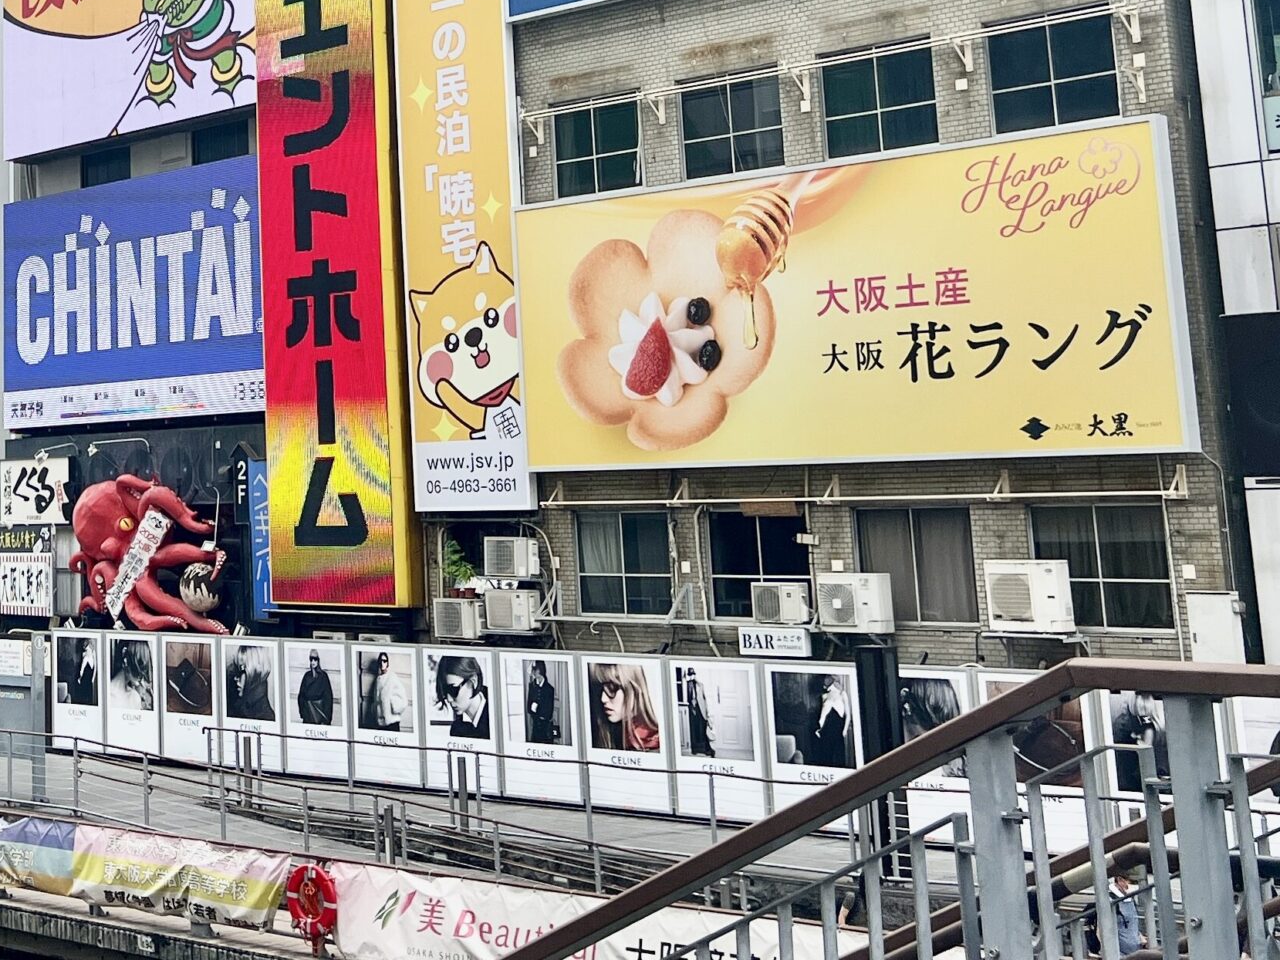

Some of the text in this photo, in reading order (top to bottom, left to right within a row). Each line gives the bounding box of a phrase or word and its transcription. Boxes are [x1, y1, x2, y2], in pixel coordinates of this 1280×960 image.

[961, 152, 1069, 214] Hana
[1000, 174, 1138, 238] Langue
[16, 188, 254, 365] CHINTAI
[816, 267, 971, 317] 大阪土産
[822, 303, 1153, 383] 大阪 花ラング
[1087, 412, 1133, 437] 大黒
[427, 451, 514, 472] www.jsv.jp
[13, 467, 55, 514] くくる
[427, 478, 517, 494] 06-4963-3661
[140, 527, 160, 545] 2025
[742, 633, 775, 650] BAR
[68, 709, 87, 717] CELINE
[122, 713, 143, 722] CELINE
[178, 718, 200, 727] CELINE
[305, 729, 329, 738] CELINE
[373, 735, 398, 745] CELINE
[526, 748, 555, 758] CELINE
[611, 755, 642, 766] CELINE
[799, 771, 835, 783] CELINE
[417, 898, 445, 936] 美
[407, 947, 433, 957] OSAKA
